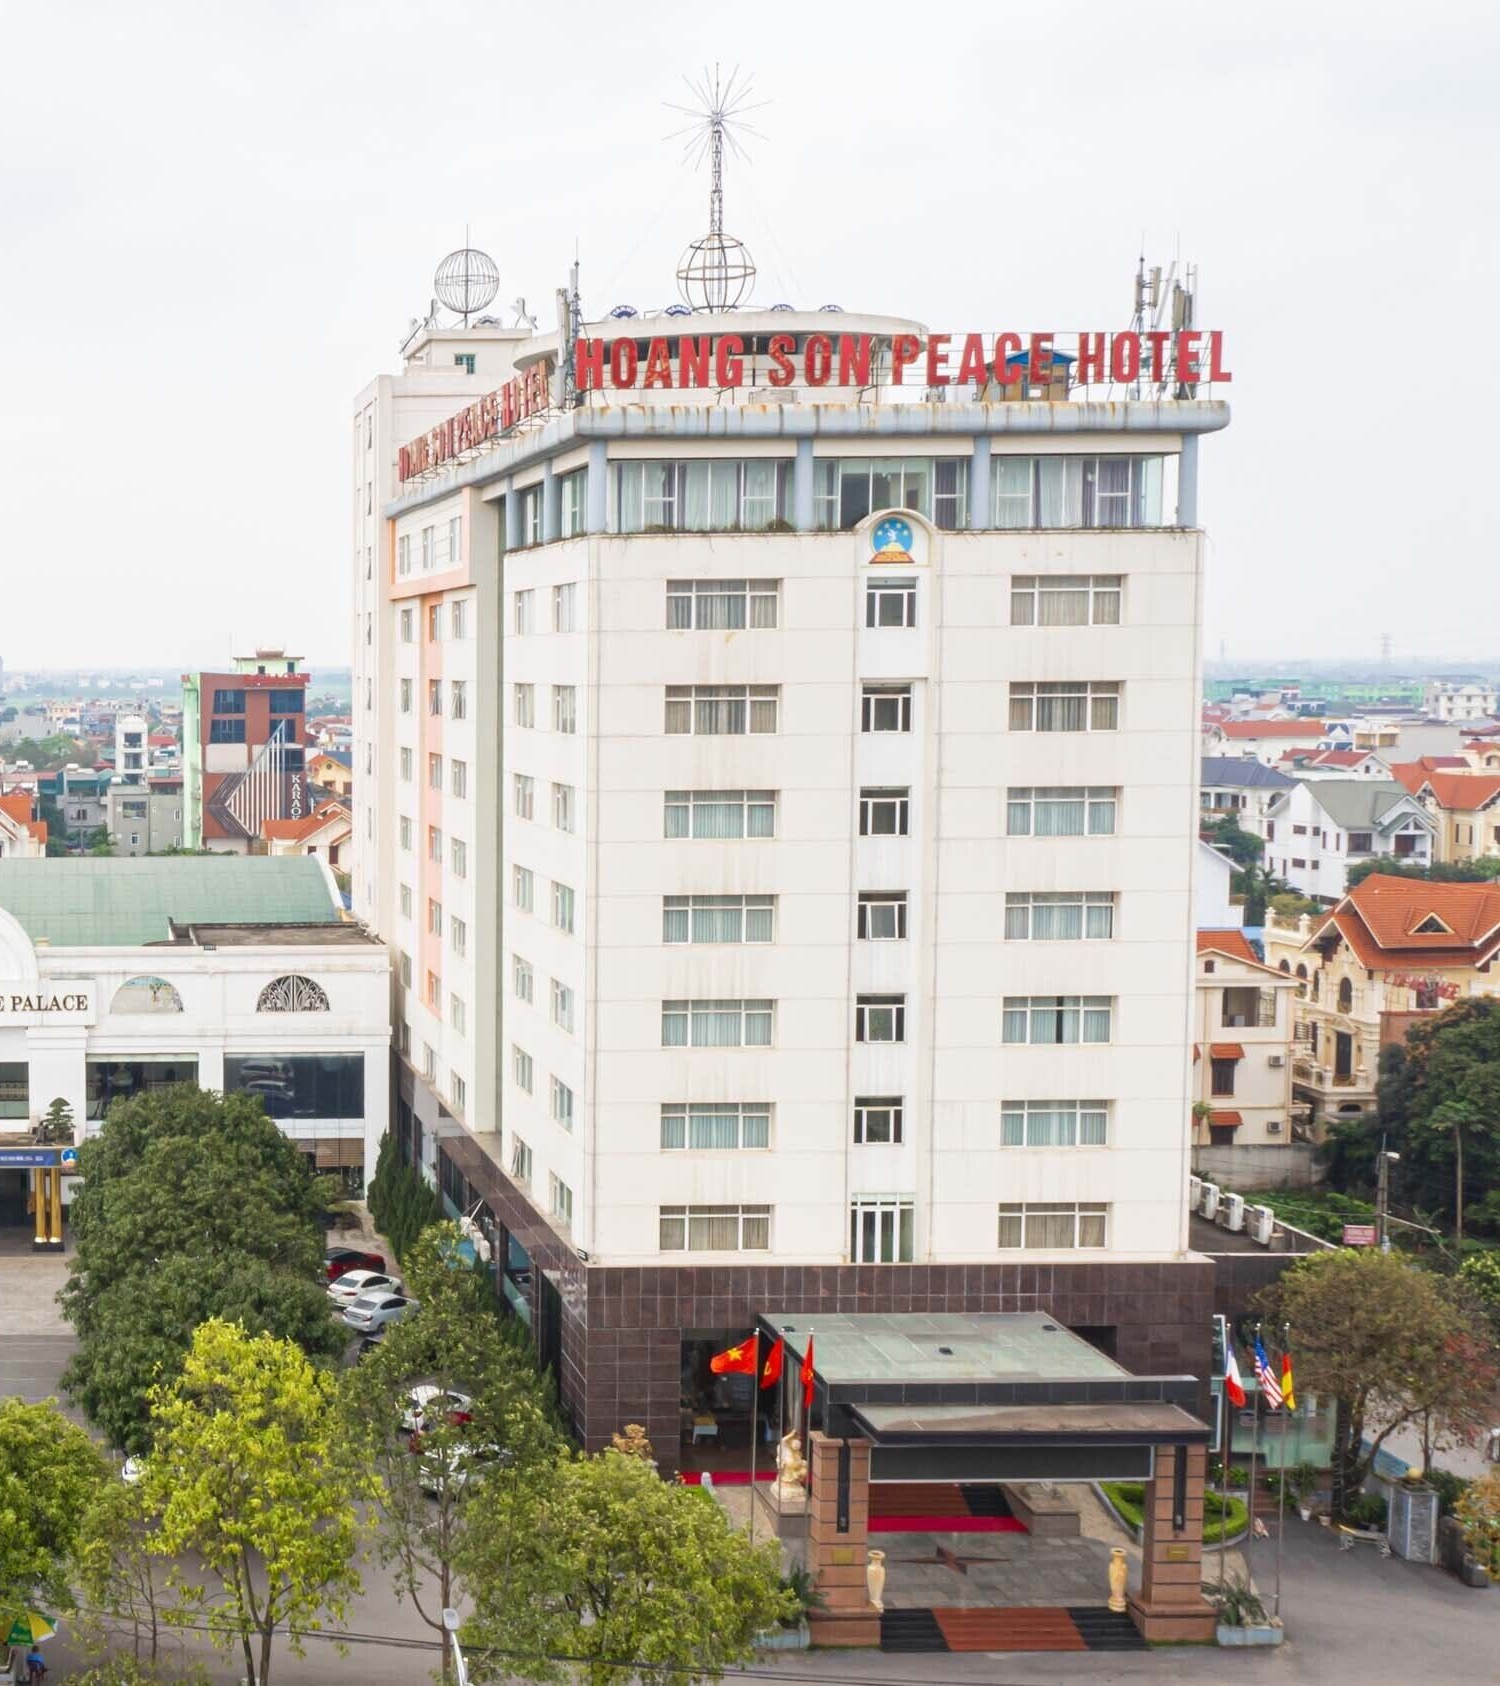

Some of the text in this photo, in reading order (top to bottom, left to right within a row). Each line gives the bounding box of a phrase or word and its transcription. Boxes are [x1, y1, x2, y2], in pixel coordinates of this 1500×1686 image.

[575, 330, 1232, 390] HOANG SON PEACE HOTEL
[501, 359, 548, 430] HOTEL
[11, 994, 88, 1012] PALACE
